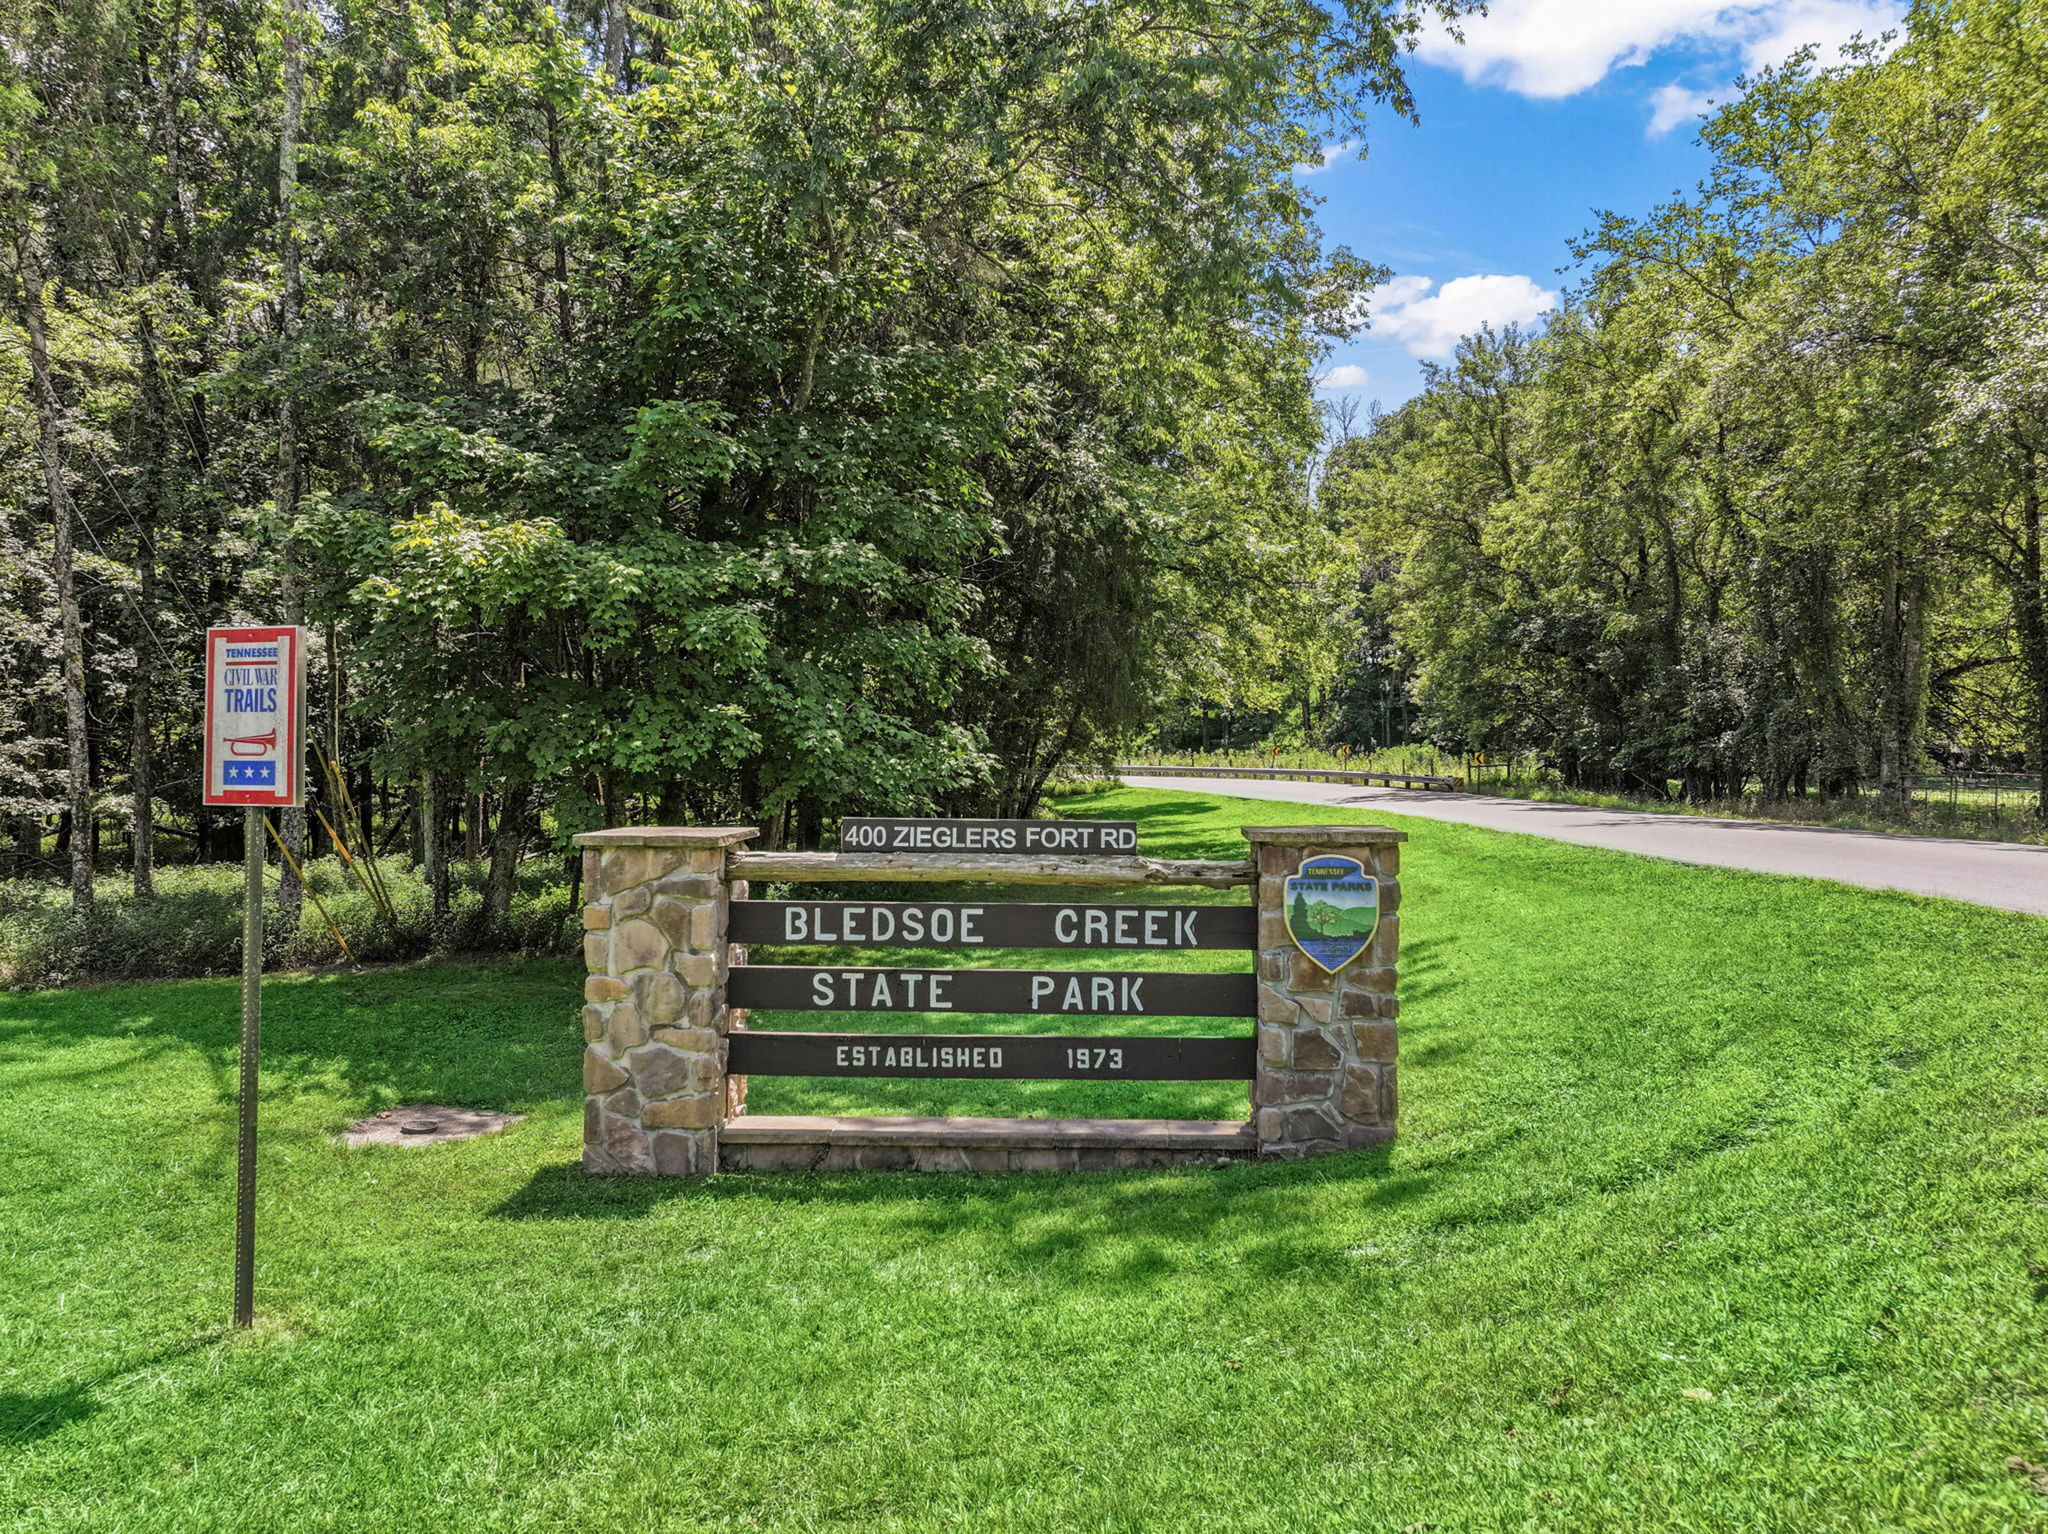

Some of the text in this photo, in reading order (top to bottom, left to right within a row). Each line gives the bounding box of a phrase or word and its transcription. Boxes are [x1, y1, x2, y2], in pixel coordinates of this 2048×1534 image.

[226, 647, 278, 658] TENNESSEE
[224, 668, 277, 686] CIVIL WAR
[224, 688, 277, 712] TRAILS
[845, 825, 1136, 849] 400 ZIEGLERS FORT RD
[1308, 868, 1344, 876] TENNESSEE
[1290, 882, 1372, 891] STATE PARKS
[785, 907, 1198, 945] BLEDSOE CREEK
[812, 972, 1144, 1011] STATE PARK
[836, 1046, 1123, 1069] ESTABLISHED 1973
